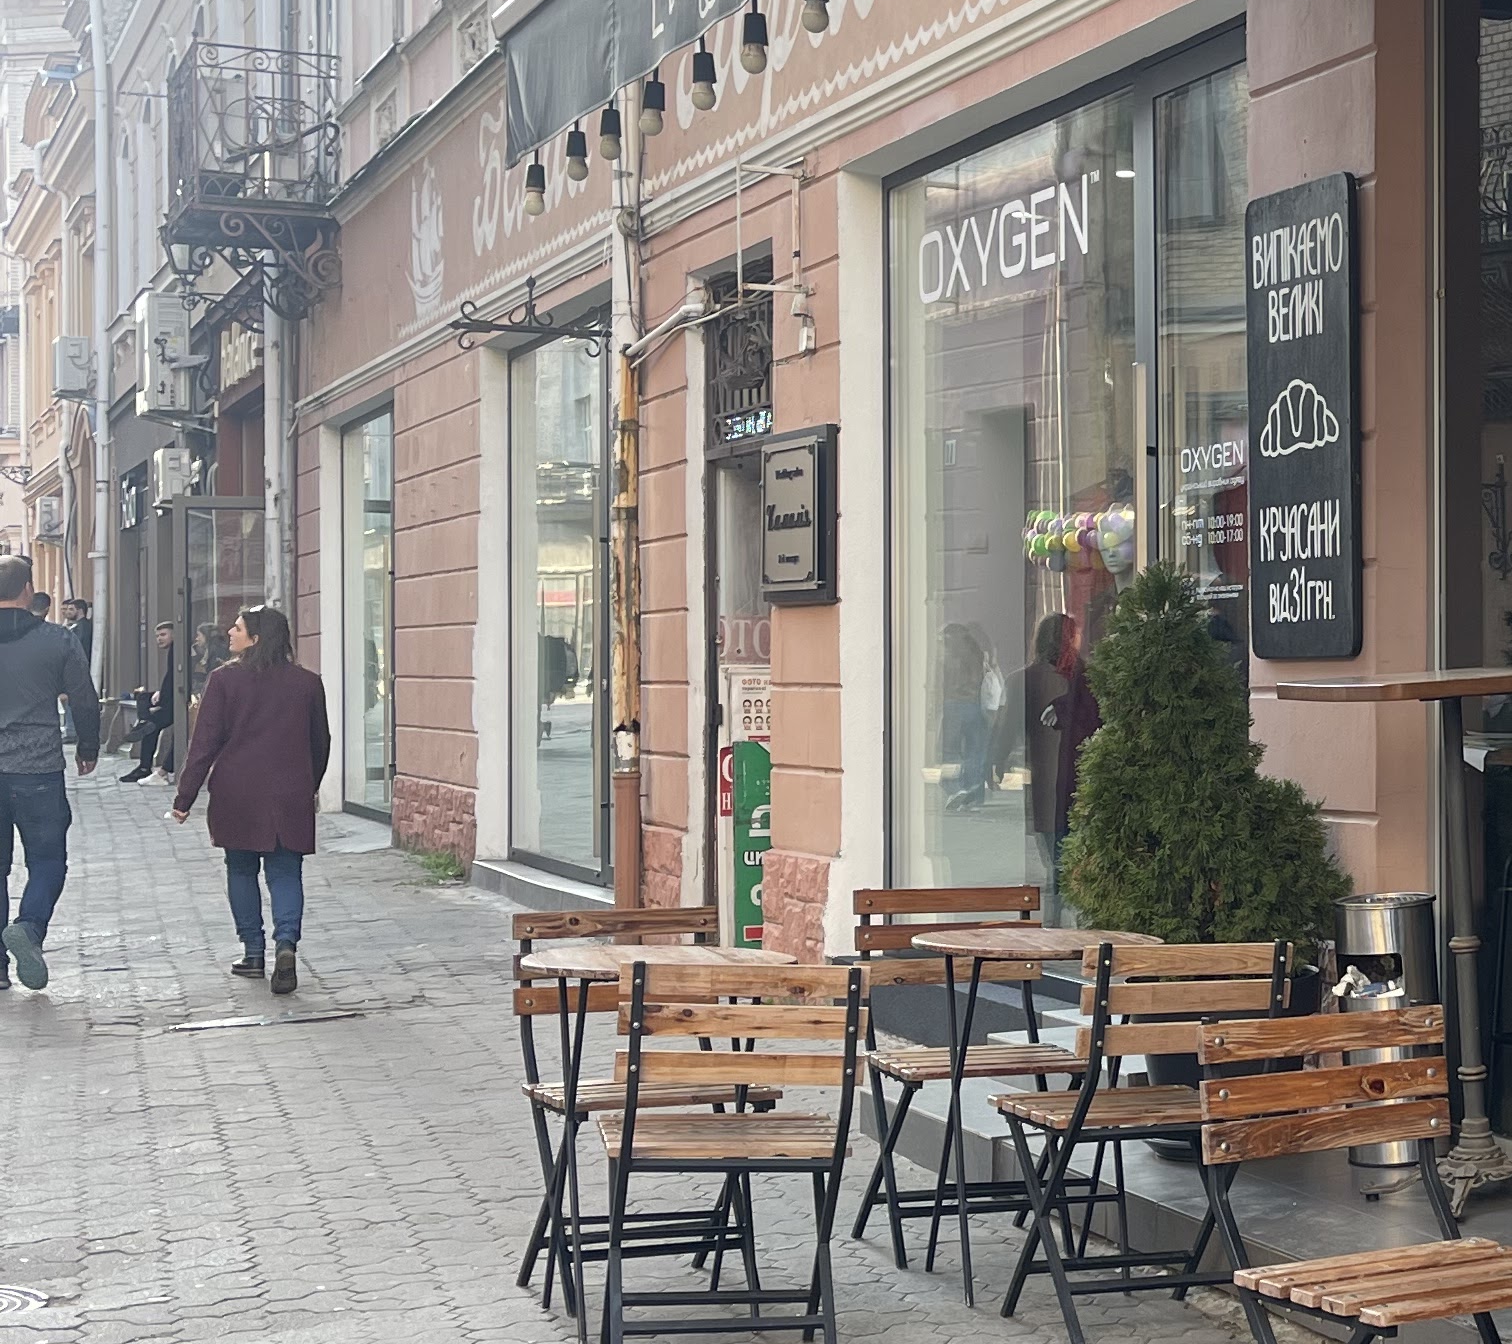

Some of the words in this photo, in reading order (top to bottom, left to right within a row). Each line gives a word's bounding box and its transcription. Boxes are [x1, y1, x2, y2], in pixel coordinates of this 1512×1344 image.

[919, 173, 1088, 304] OXYGEN
[1252, 212, 1343, 290] ВИПІКАЄМО
[1268, 278, 1323, 343] ВЕЛИКІ
[1180, 440, 1244, 473] OXYGEN
[1260, 498, 1341, 562] КРУАСАНИ
[1269, 582, 1291, 623] ВІД
[1290, 565, 1306, 623] 31
